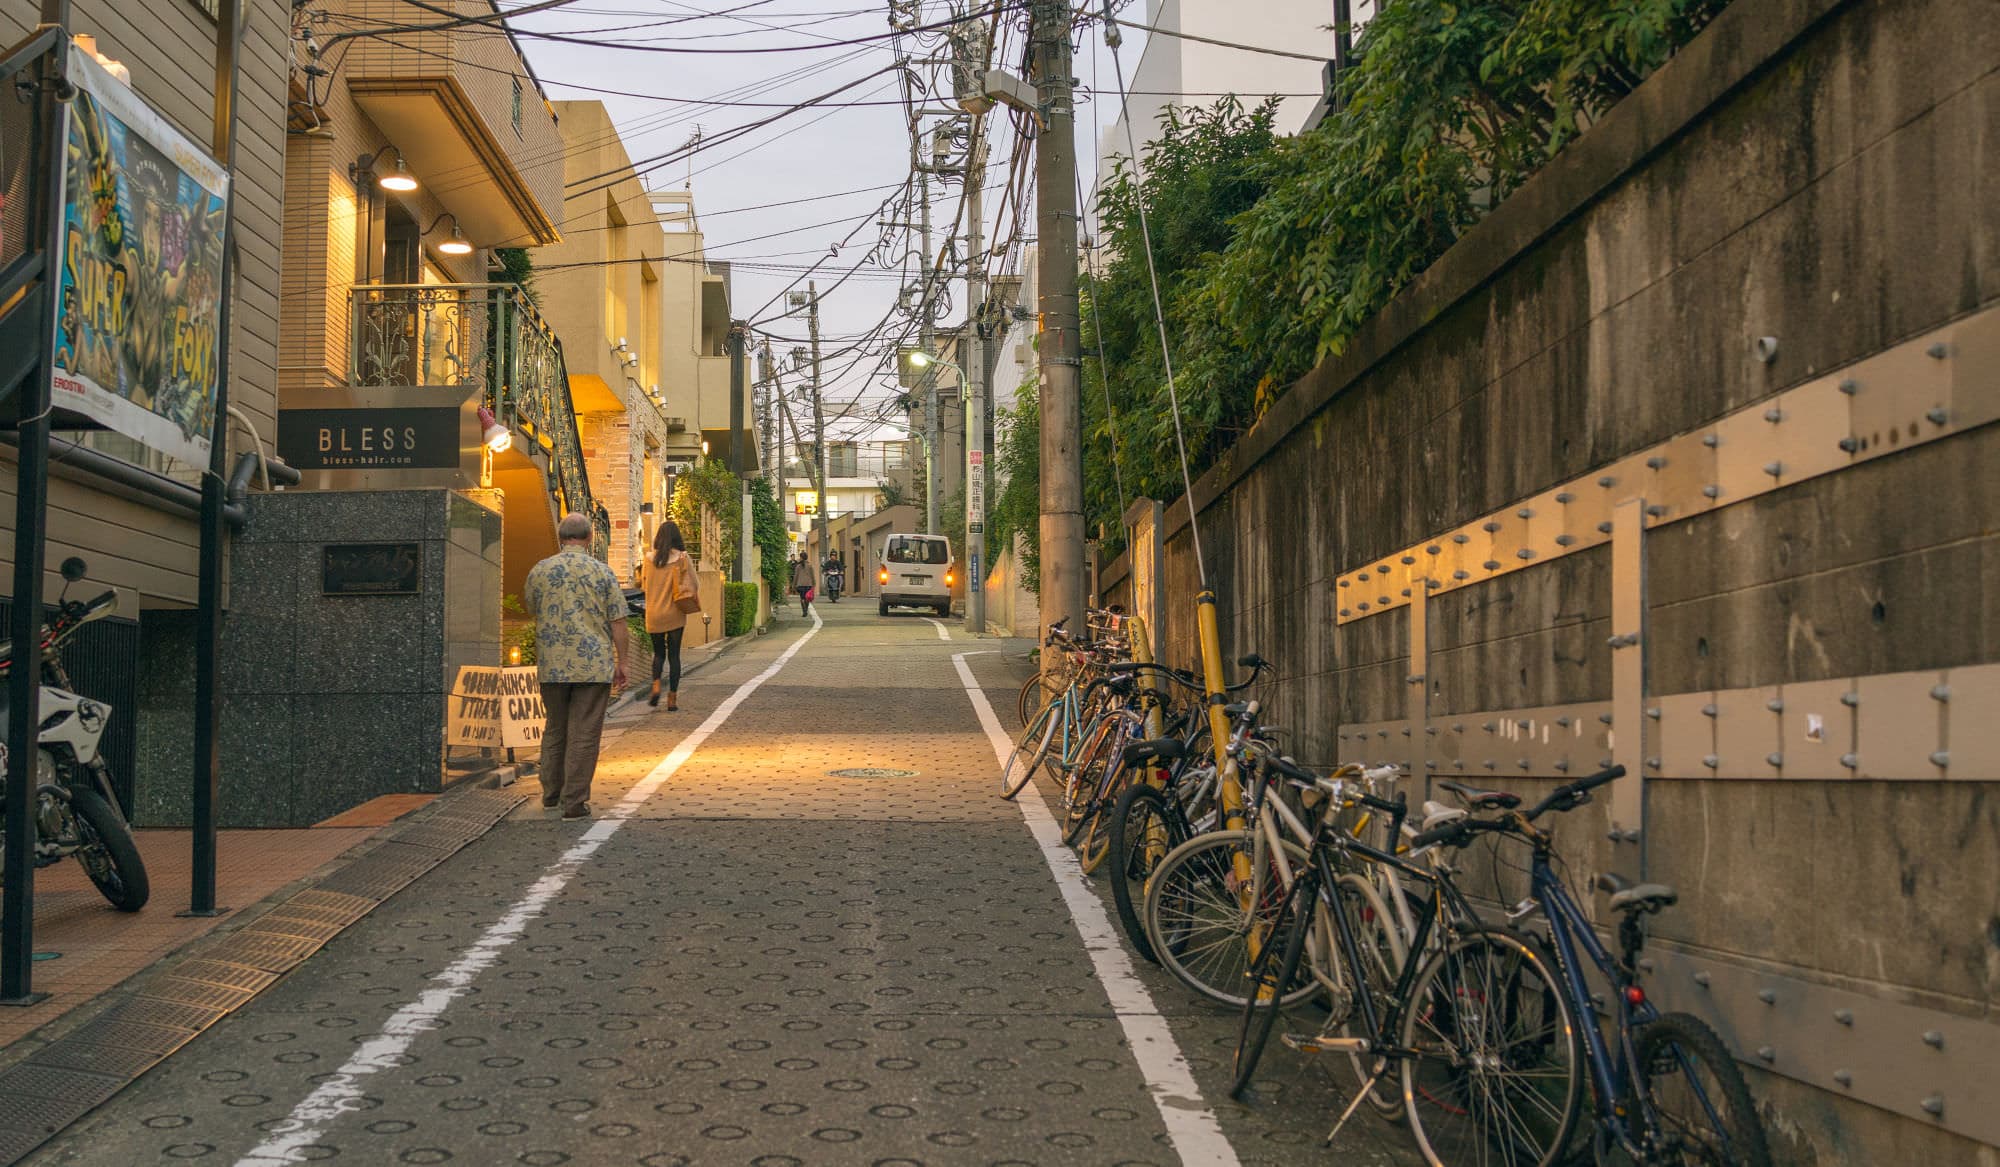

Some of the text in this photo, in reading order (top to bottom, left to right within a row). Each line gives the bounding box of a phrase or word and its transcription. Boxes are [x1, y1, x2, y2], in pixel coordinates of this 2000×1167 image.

[68, 228, 126, 336] SUPER
[172, 305, 214, 397] FOXY
[319, 427, 416, 452] BLESS
[322, 456, 412, 465] bless-hair.com
